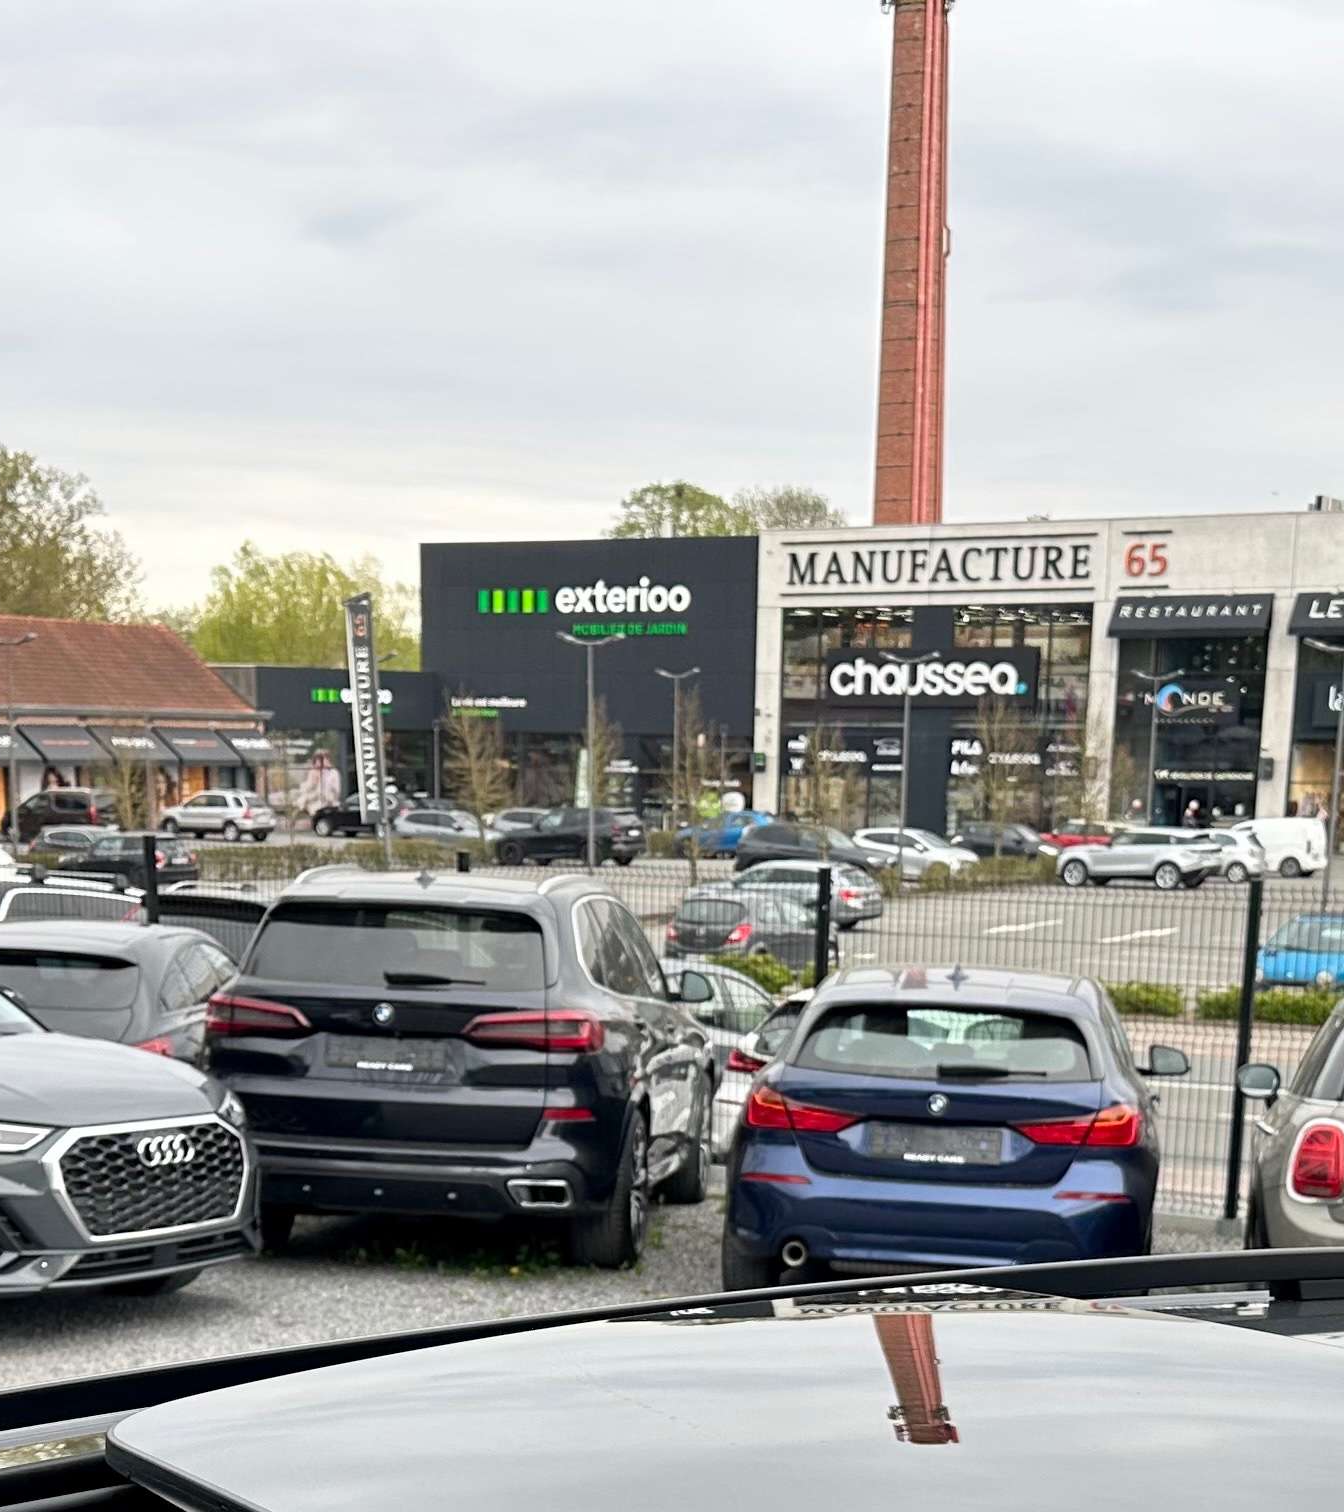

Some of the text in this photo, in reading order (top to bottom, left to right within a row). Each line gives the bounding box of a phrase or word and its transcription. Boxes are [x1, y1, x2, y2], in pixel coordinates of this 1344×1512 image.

[786, 542, 1169, 586] MANUFACTURE 65
[555, 575, 692, 614] exterioo
[1118, 602, 1263, 619] RESTAURANT
[646, 622, 688, 635] JARDIN
[355, 645, 381, 811] MANUFACTURE
